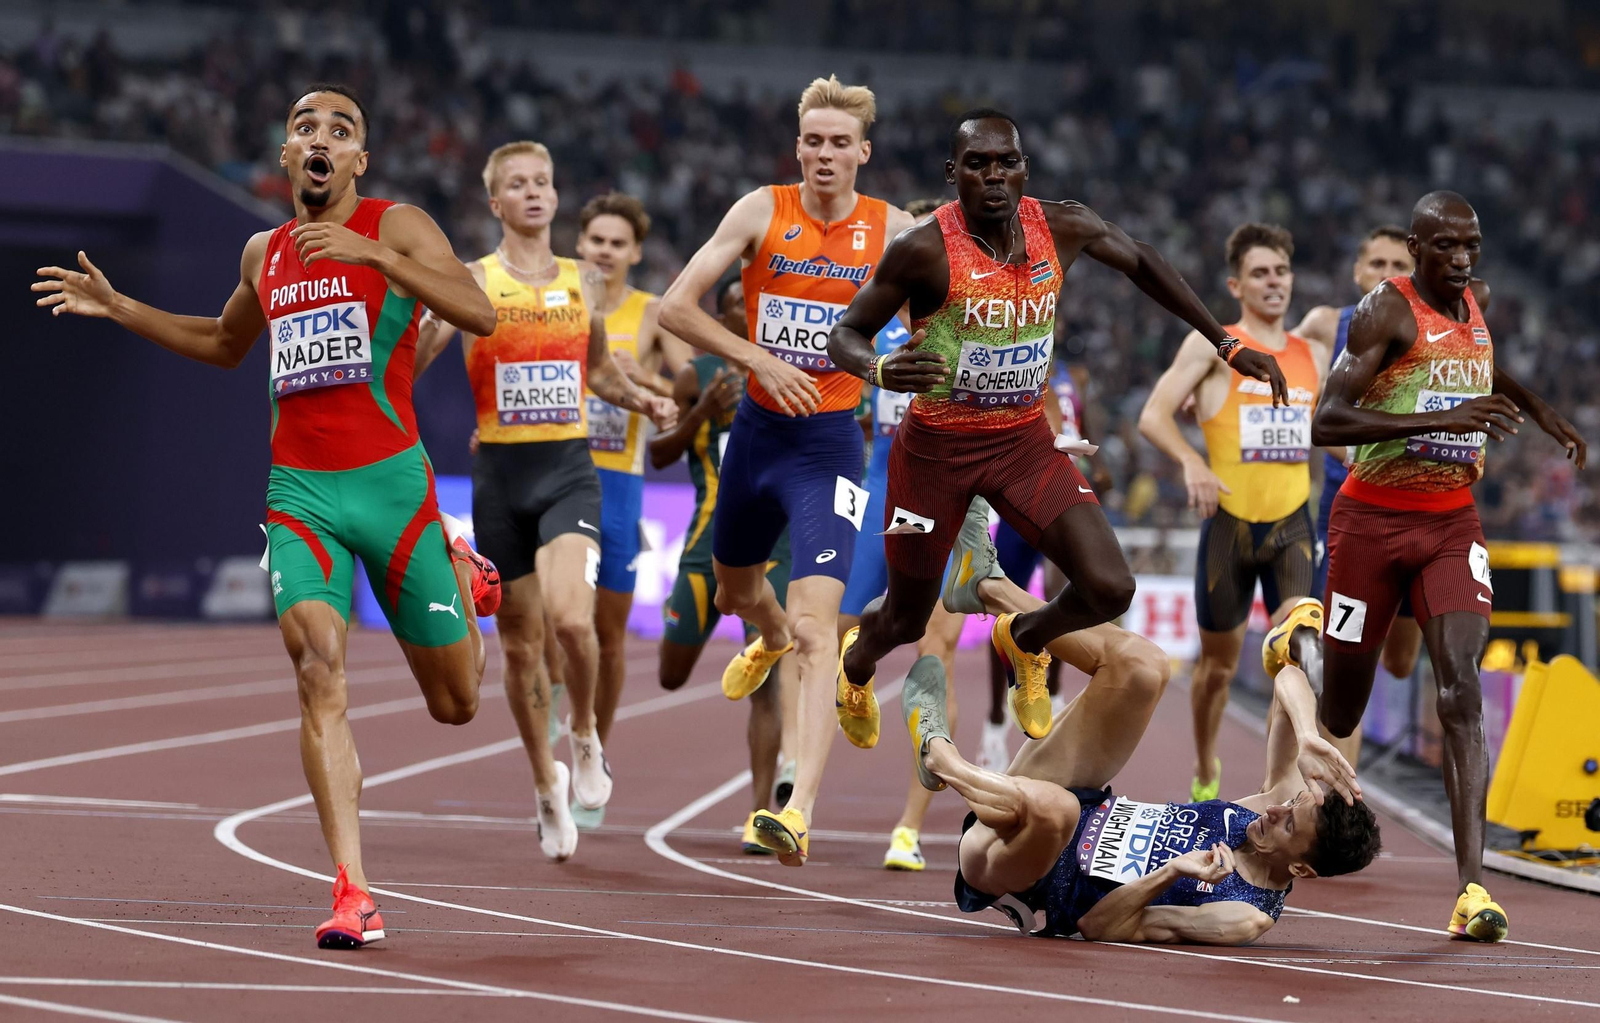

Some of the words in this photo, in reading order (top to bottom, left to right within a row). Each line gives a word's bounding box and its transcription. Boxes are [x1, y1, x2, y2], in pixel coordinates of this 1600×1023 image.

[768, 254, 869, 281] Nederland
[270, 276, 353, 310] PORTUGAL
[292, 307, 358, 338] TDK
[496, 306, 582, 325] GERMANY
[785, 301, 849, 326] TDK
[964, 291, 1056, 328] KENYA
[762, 323, 829, 351] LARO
[277, 336, 363, 373] NADER
[992, 338, 1049, 367] TDK
[292, 370, 344, 386] TOKYO
[348, 369, 367, 379] 25
[521, 364, 575, 382] TDK
[959, 370, 971, 388] R.
[976, 361, 1047, 390] CHERUIYOT
[1428, 359, 1491, 387] KENYA
[503, 387, 577, 407] FARKEN
[979, 393, 1032, 404] TOKYO
[520, 411, 567, 420] TOKYO
[1264, 407, 1308, 424] TDK
[1262, 429, 1303, 446] BEN
[1431, 446, 1478, 460] TOKYO
[847, 488, 856, 517] 3
[1335, 602, 1355, 632] 7
[1082, 811, 1105, 850] TOKYO
[1092, 803, 1138, 875] WIGHTMAN
[1160, 809, 1199, 863] GREA
[1121, 820, 1158, 877] TDK
